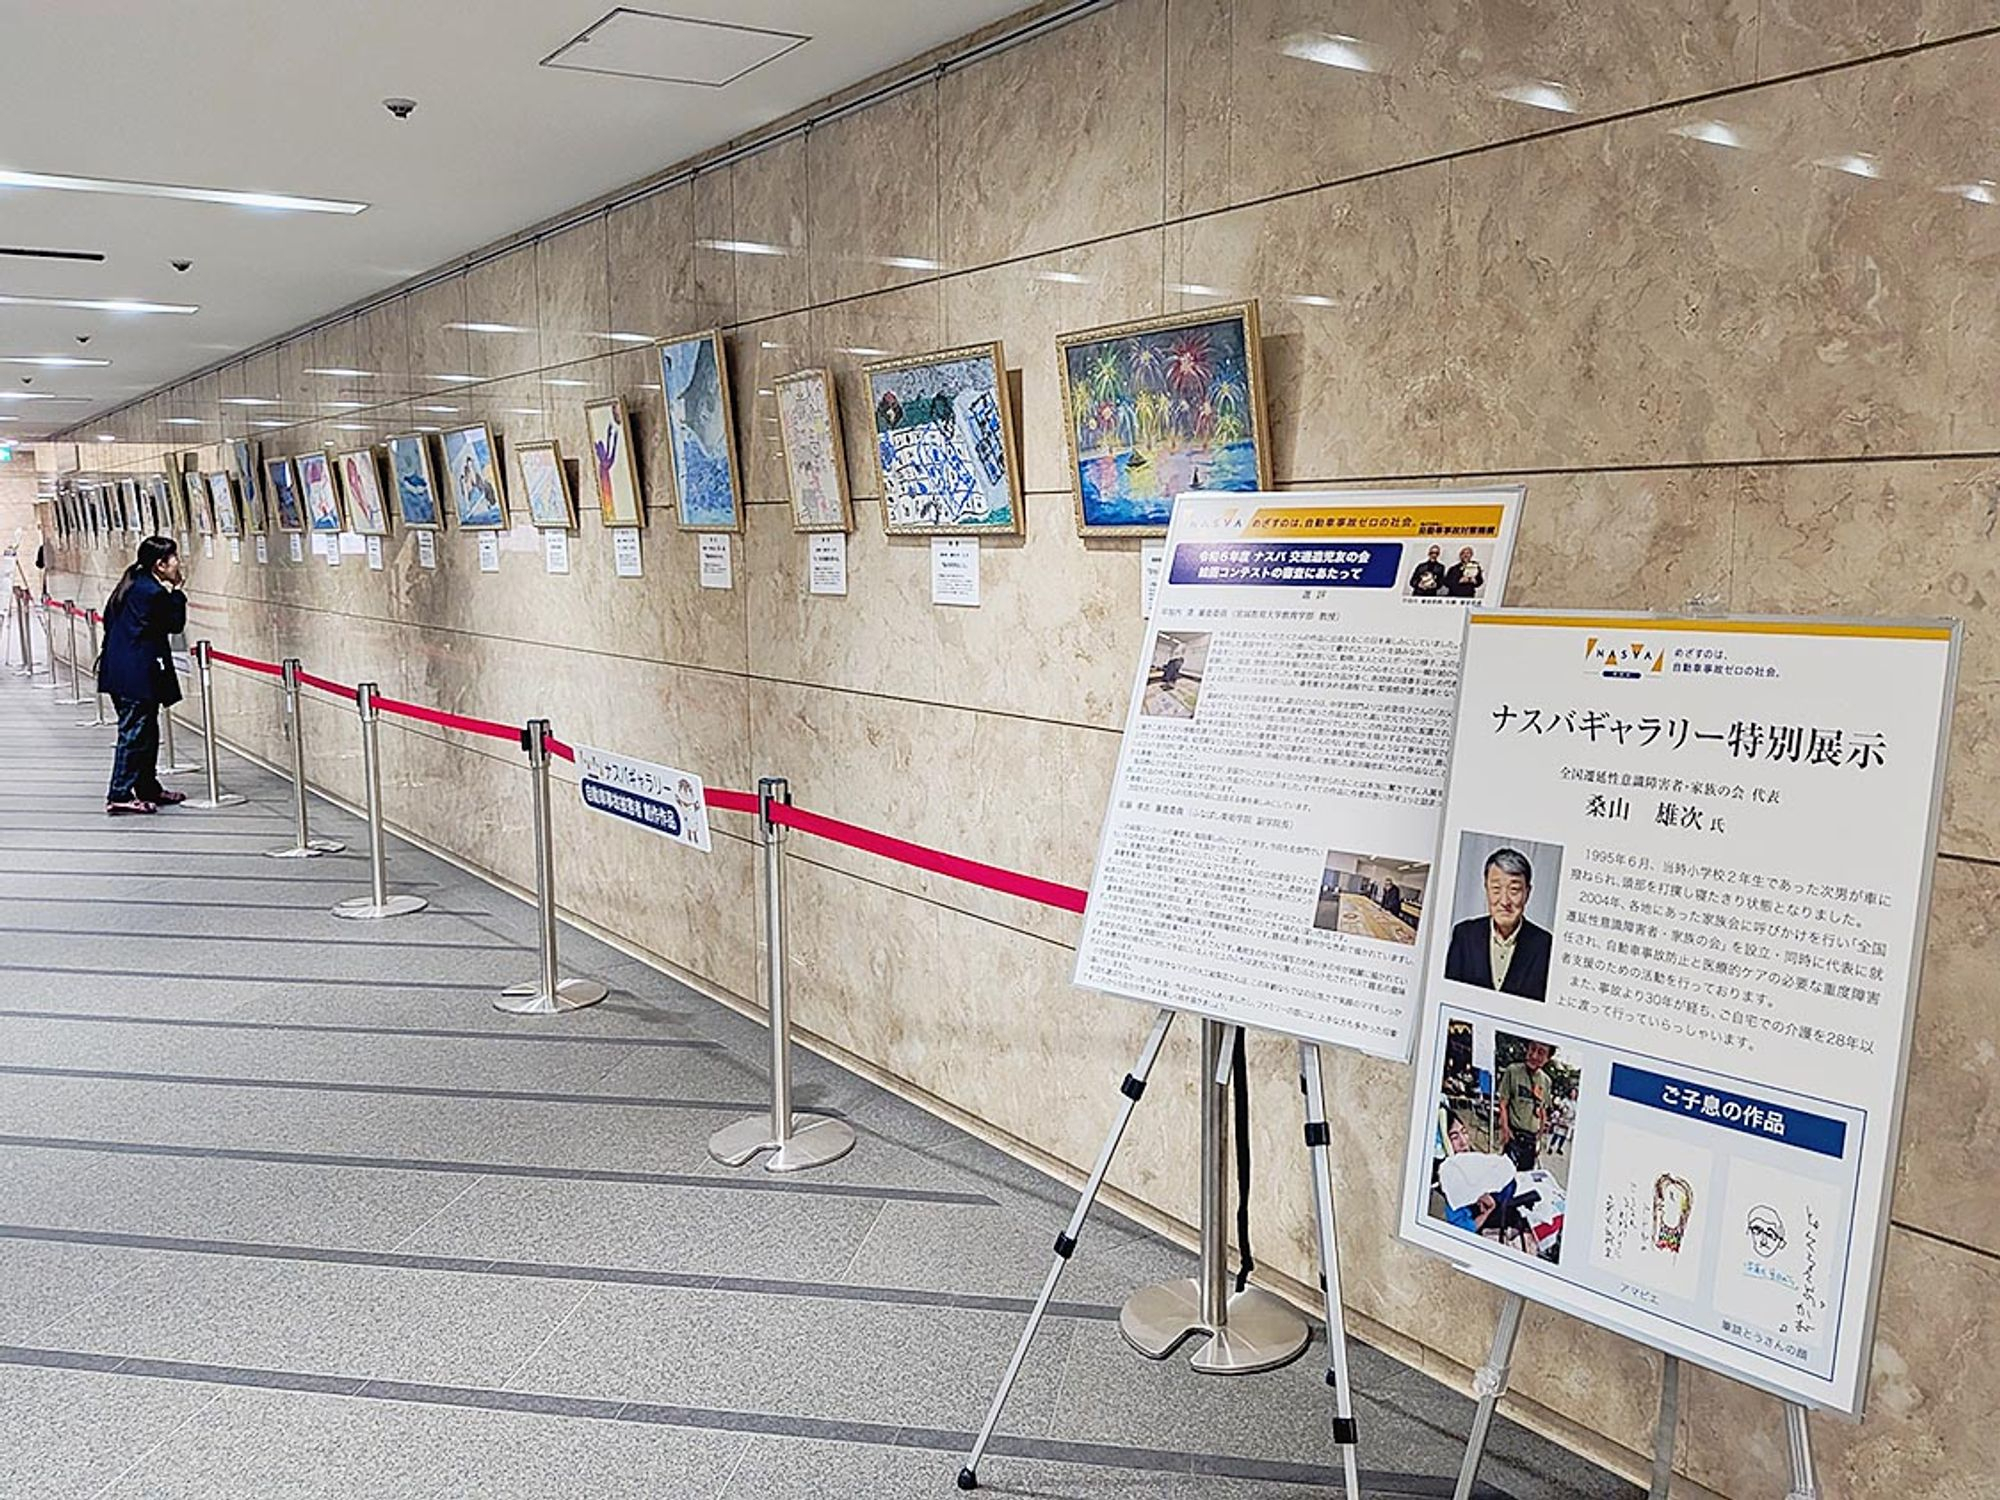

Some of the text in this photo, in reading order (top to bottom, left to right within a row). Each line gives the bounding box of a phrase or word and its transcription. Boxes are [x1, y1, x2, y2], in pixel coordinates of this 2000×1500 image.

[1672, 663, 1780, 679] 自動車事故ゼロの社会。
[1491, 703, 1888, 770] ナスバギャラリー特別展示
[1752, 788, 1780, 805] 代表
[1585, 793, 1726, 834] 桑山 雄次 氏
[1661, 1084, 1786, 1136] ご子息の作品
[1620, 1283, 1660, 1306] アマビエ
